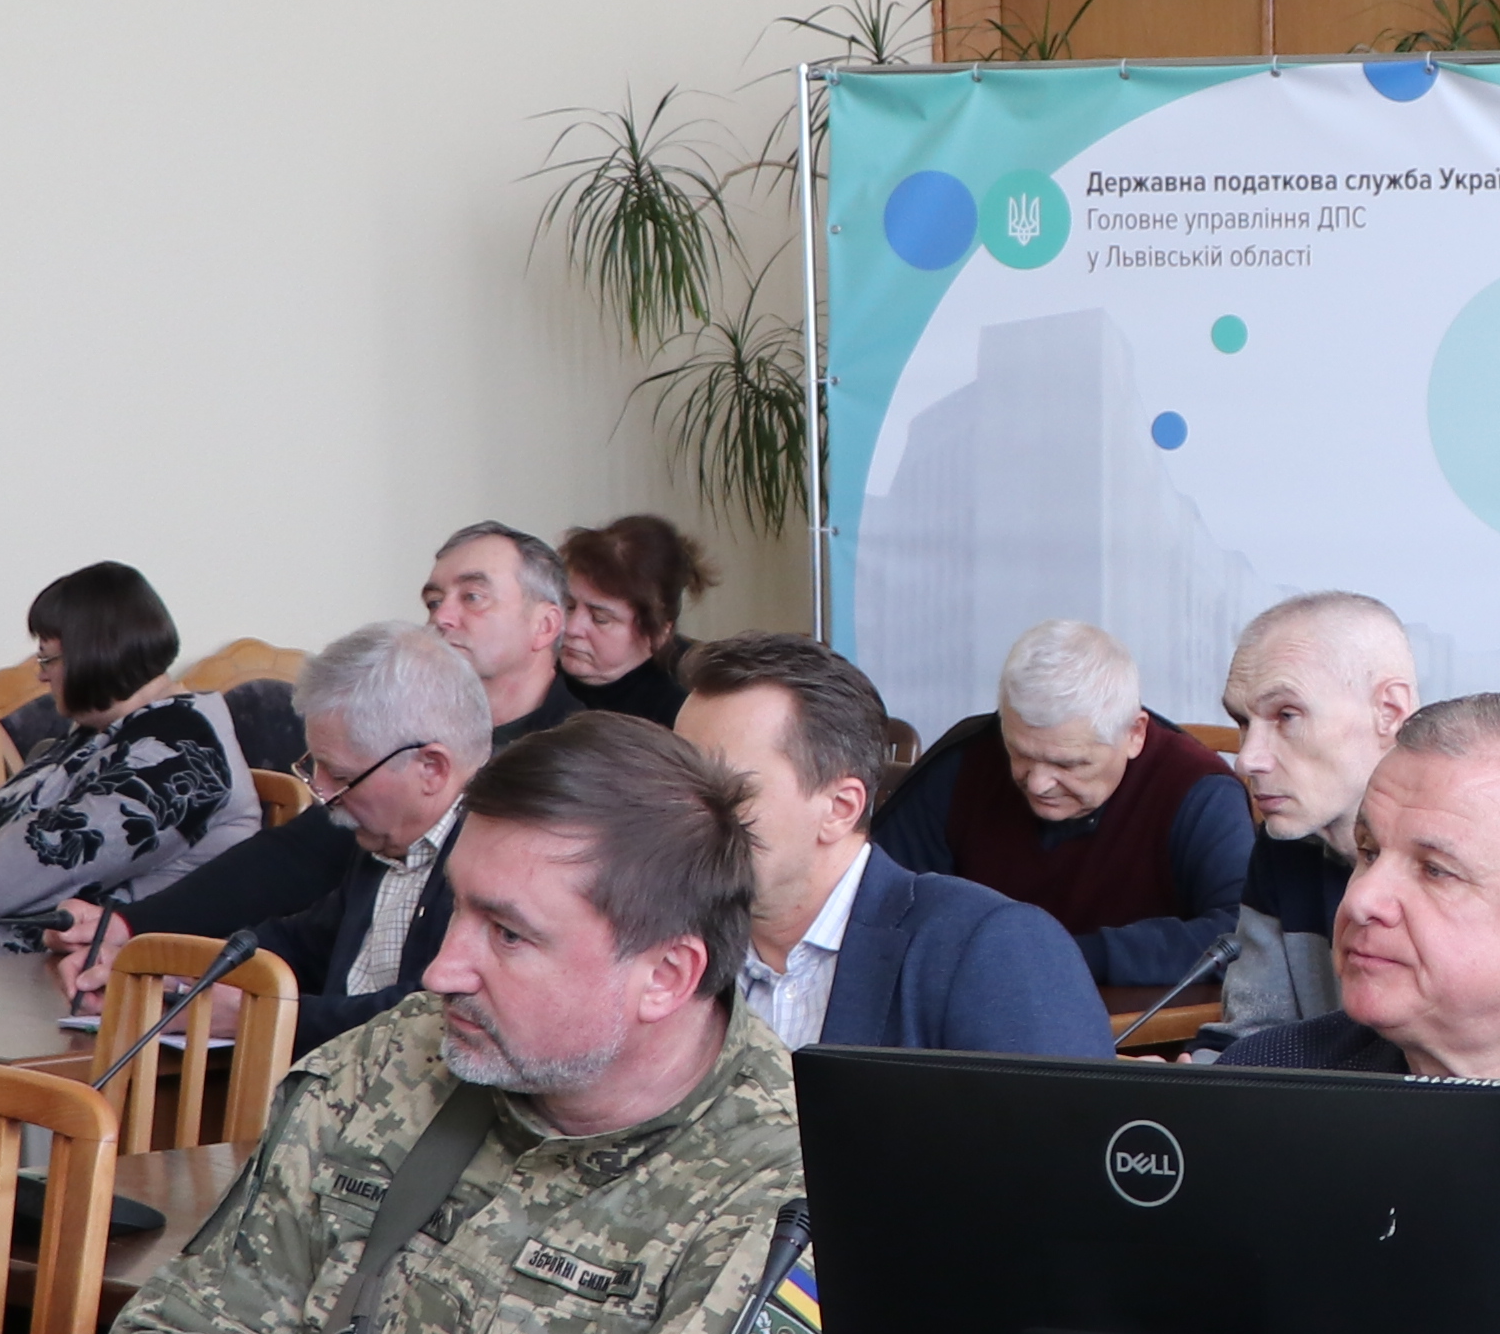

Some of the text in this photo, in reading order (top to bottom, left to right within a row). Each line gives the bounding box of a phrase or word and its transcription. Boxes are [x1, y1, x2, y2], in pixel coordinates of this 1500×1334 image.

[1086, 170, 1207, 197] Державна
[1213, 174, 1338, 194] податкова
[1344, 169, 1433, 197] служба
[1086, 206, 1367, 237] Головне управління ДПС
[1087, 244, 1313, 273] у Львівській області
[1116, 1152, 1177, 1176] DELL
[528, 1250, 579, 1280] ЗБРОЙНІ
